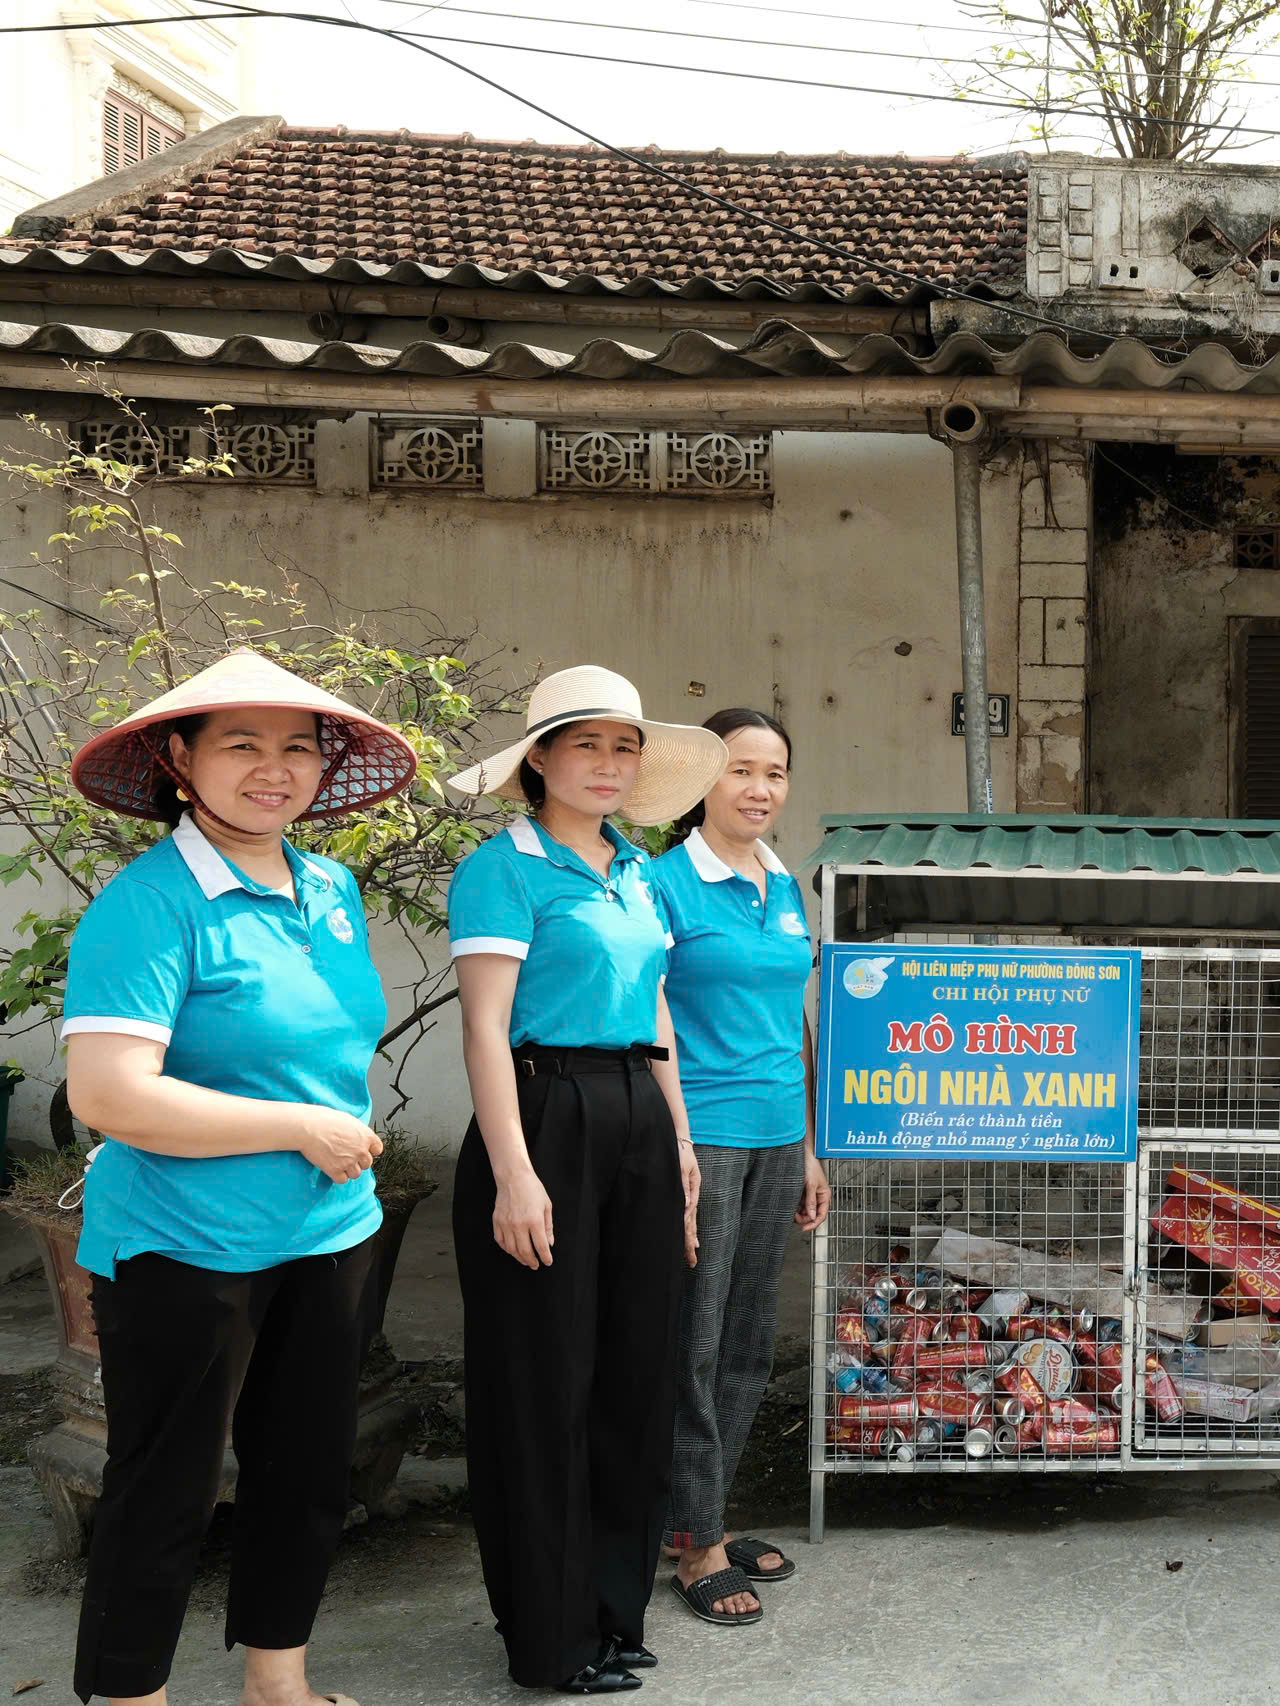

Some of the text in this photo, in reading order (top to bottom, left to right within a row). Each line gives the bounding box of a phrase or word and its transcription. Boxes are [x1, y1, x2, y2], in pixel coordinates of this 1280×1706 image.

[959, 697, 1003, 723] 9
[902, 960, 921, 979] HỘI
[923, 960, 947, 976] LIÊN
[951, 961, 974, 980] HIỆP
[977, 963, 999, 980] PHỤ
[1002, 962, 1019, 978] NỮ
[1020, 962, 1063, 979] PHƯỜNG
[1098, 966, 1121, 980] SƠN
[933, 984, 1091, 1005] CHI HỘI PHỤ NỮ
[887, 1013, 1077, 1055] MÔ HÌNH
[843, 1062, 1116, 1107] NGÔI NHÀ XANH
[901, 1111, 1063, 1128] (Biến rác thành tiền
[845, 1130, 1116, 1150] hành động nhỏ mang ý nghĩa lớn)
[1048, 1348, 1063, 1392] Danisa
